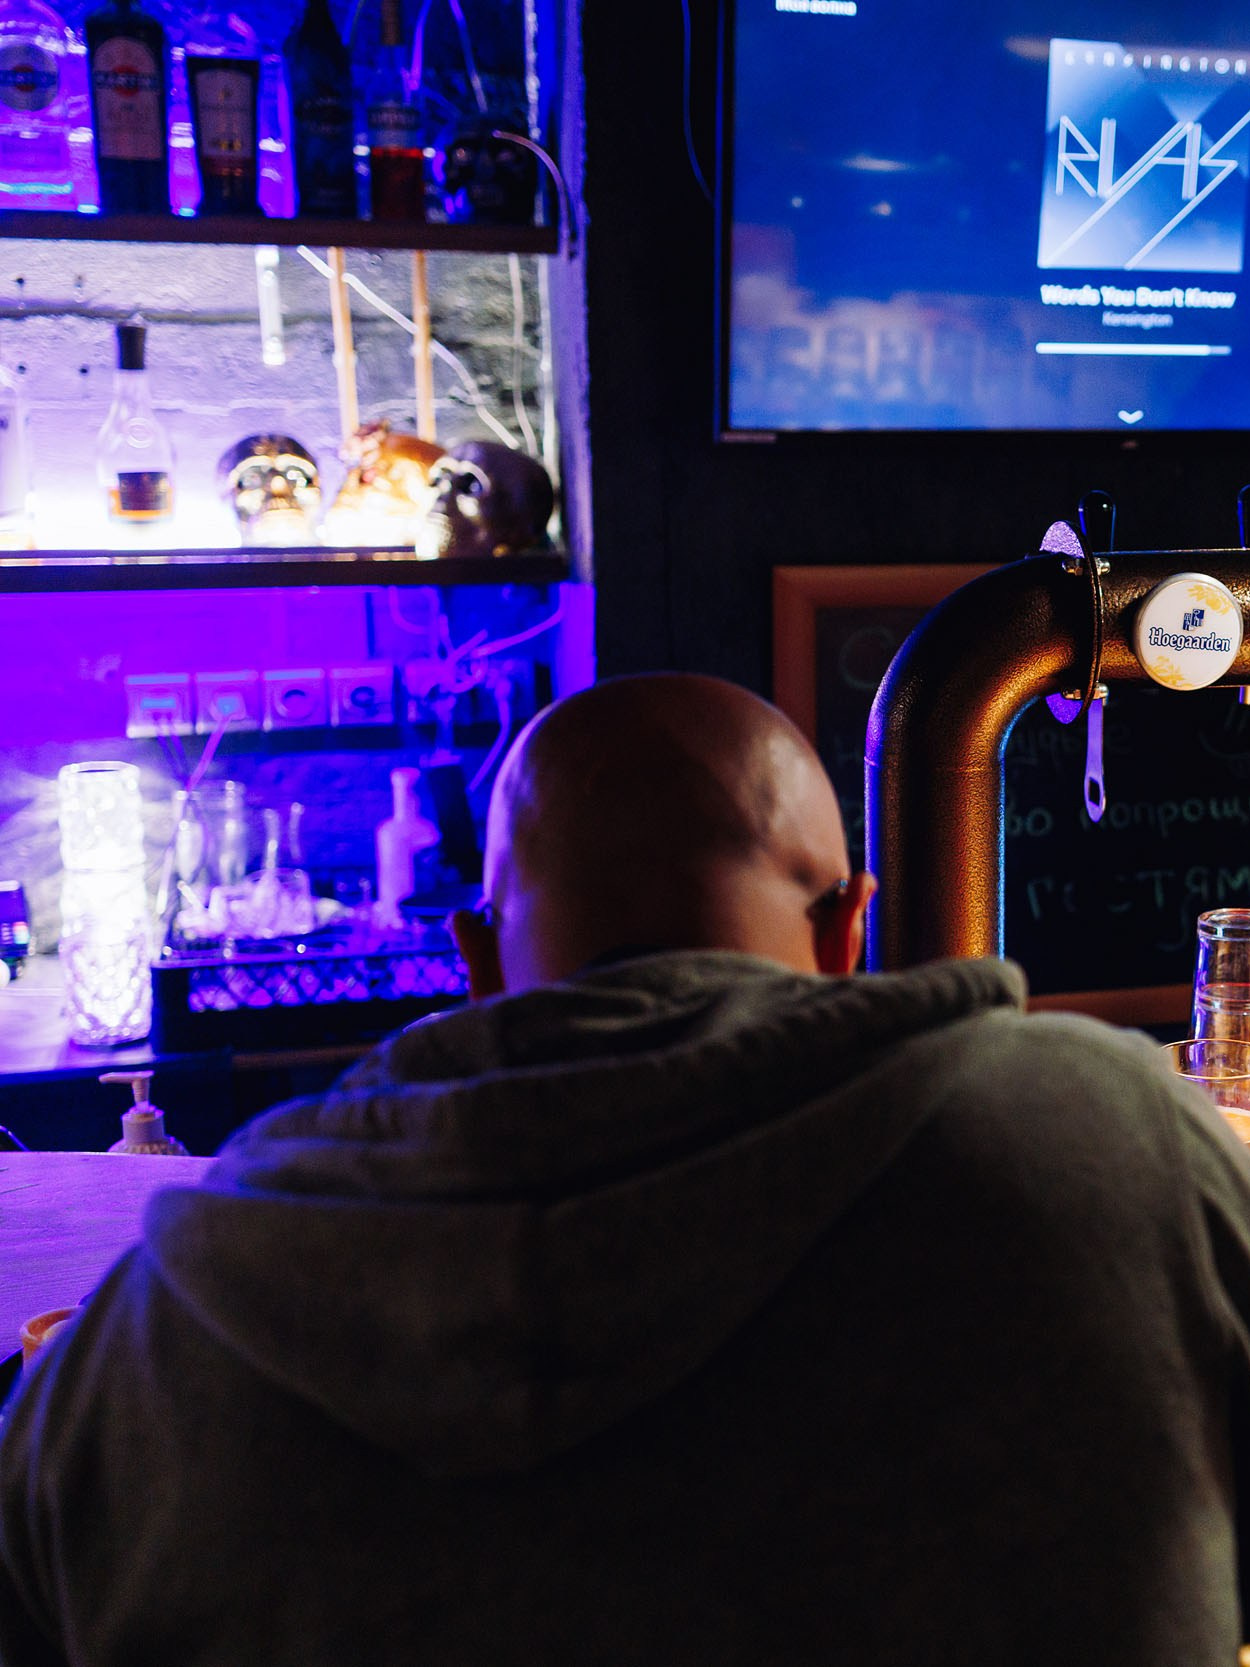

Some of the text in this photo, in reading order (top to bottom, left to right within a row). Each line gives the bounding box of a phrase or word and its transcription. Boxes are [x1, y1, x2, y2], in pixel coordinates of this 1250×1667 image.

[1041, 285, 1236, 308] Words You Don't Know
[1149, 627, 1230, 652] Hoegaarden
